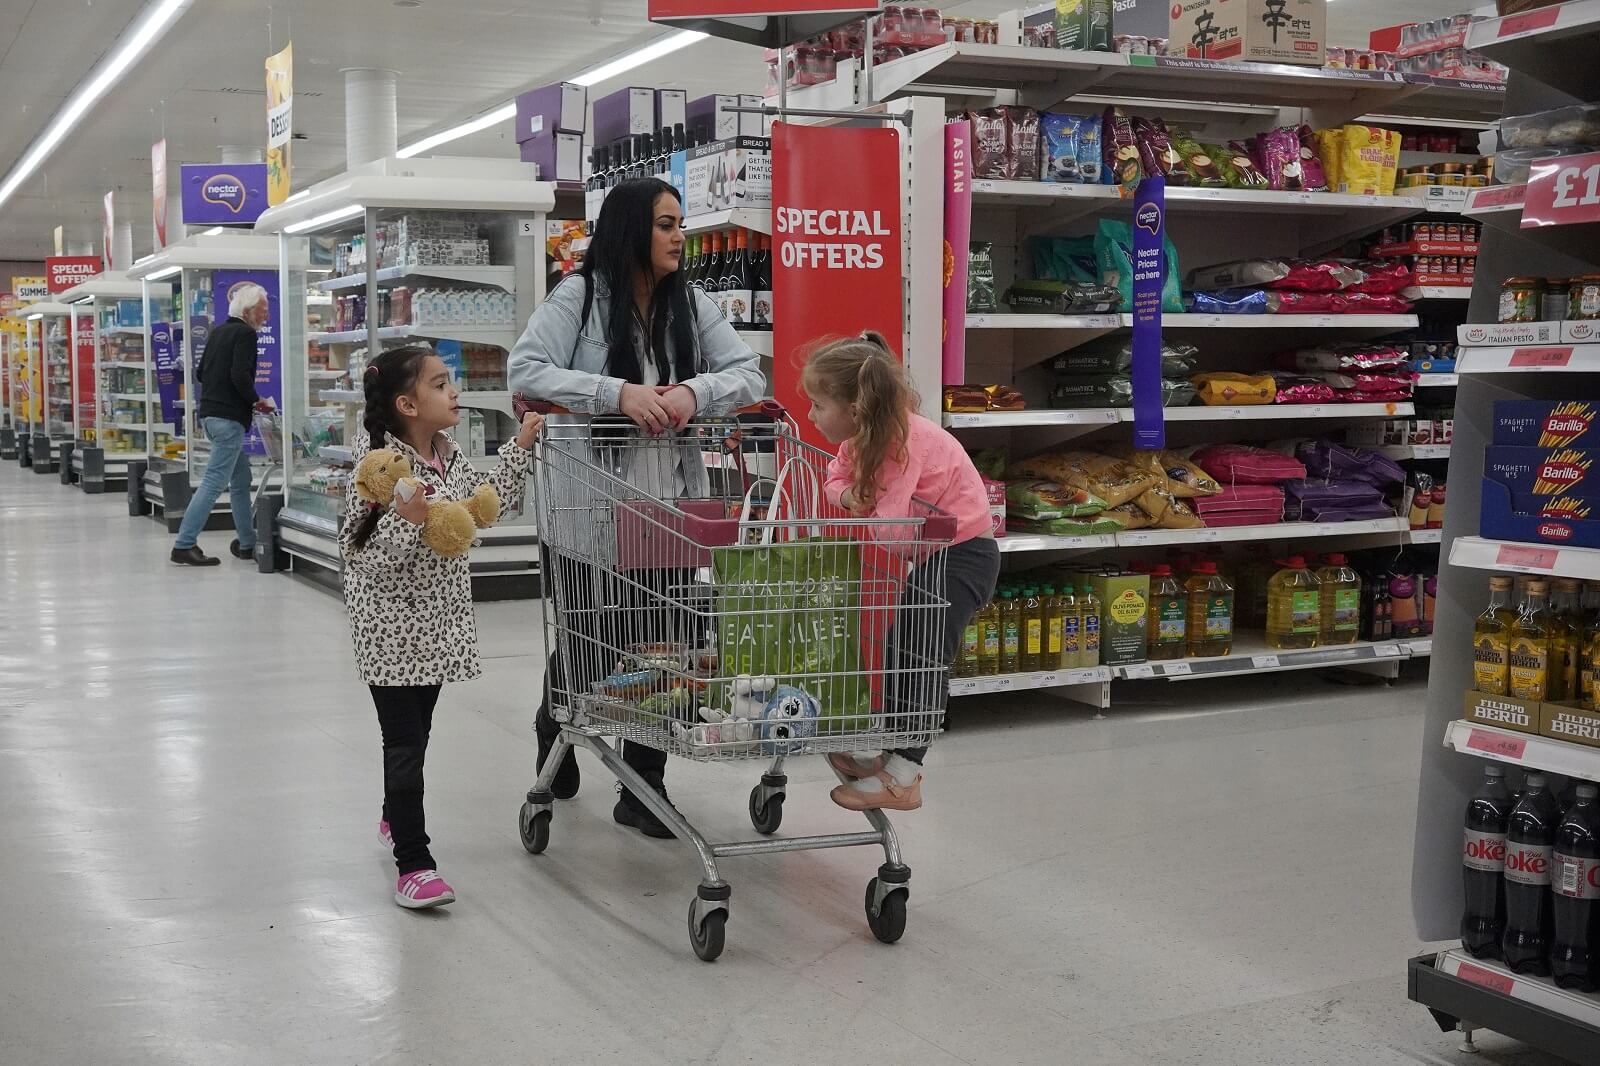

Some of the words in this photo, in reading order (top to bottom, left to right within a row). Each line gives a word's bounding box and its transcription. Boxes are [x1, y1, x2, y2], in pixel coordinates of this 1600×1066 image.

[1219, 26, 1238, 41] 라면
[742, 139, 764, 147] BREAD
[952, 138, 964, 193] ASIAN
[207, 185, 239, 193] nectar
[776, 206, 890, 236] SPECIAL
[1139, 211, 1158, 220] nectar
[524, 224, 530, 232] S
[781, 241, 884, 269] OFFERS
[1137, 248, 1160, 258] Nectar
[52, 264, 96, 274] SPECIAL
[1137, 260, 1158, 270] Prices
[1134, 273, 1146, 281] are
[1146, 270, 1160, 280] here
[20, 287, 50, 297] SUMME
[1513, 334, 1534, 342] PESTO
[1500, 418, 1536, 426] SPAGHETTI
[1547, 419, 1584, 432] Barilla
[1493, 464, 1530, 472] SPAGHETTI
[1542, 466, 1579, 480] Barilla
[1541, 525, 1569, 537] Barilla
[726, 623, 778, 645] EAT.
[1479, 699, 1525, 714] FILIPPO
[1474, 705, 1530, 727] BERIO
[1557, 712, 1600, 727] FILIPP
[1550, 719, 1600, 740] BERI
[1464, 839, 1506, 861] oke
[1505, 850, 1548, 874] oke
